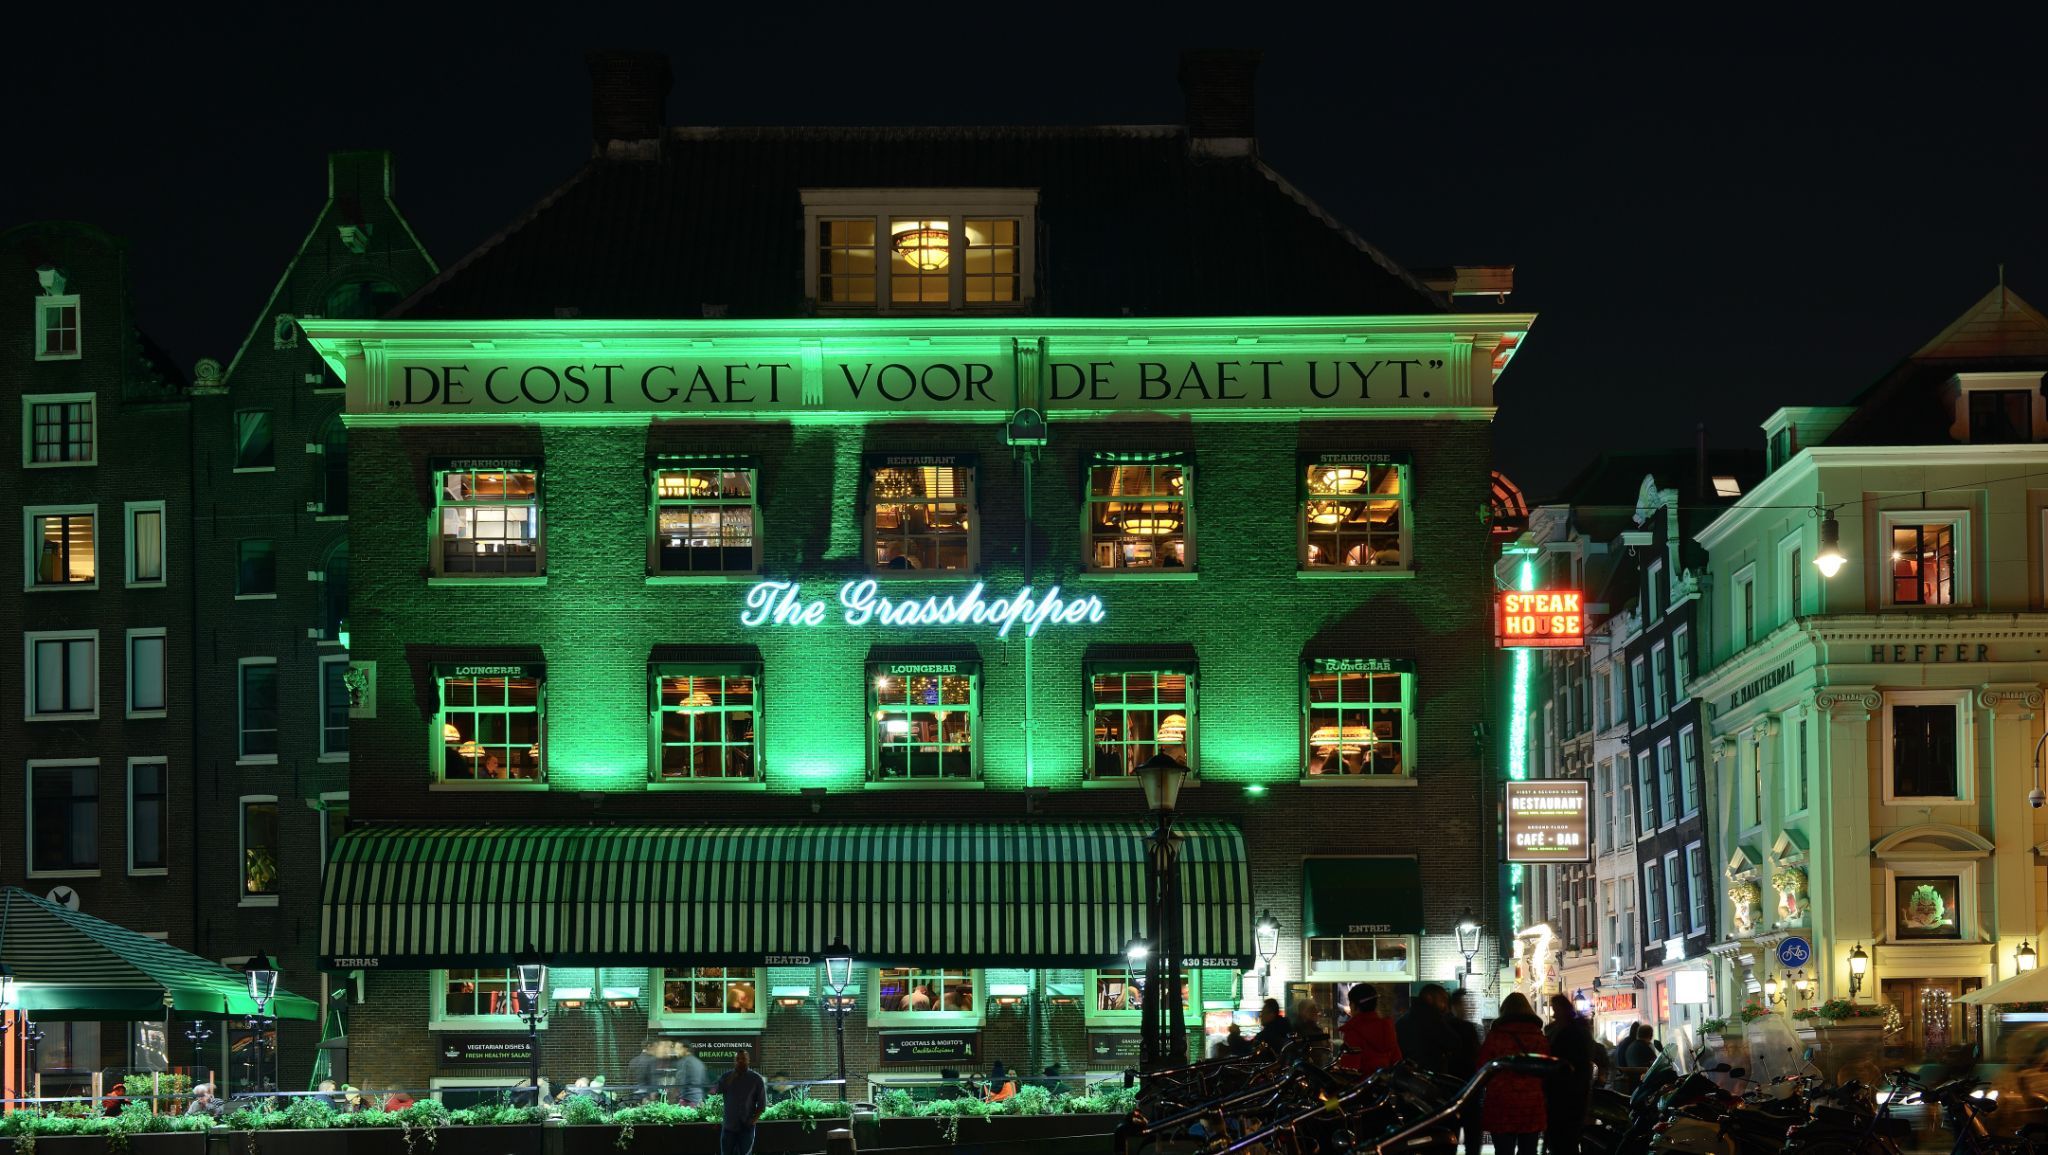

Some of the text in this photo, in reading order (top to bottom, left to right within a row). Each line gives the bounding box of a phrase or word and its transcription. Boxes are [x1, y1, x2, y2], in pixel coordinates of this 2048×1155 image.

[485, 363, 624, 404] COST
[640, 362, 792, 404] GAET
[839, 363, 998, 403] VOOR
[1048, 360, 1120, 401] DE
[1137, 359, 1285, 401] BAET
[886, 455, 956, 465] RESTAURANT
[1319, 453, 1391, 463] STEAKHOUSE
[450, 459, 522, 468] STEAKHOUSE
[1505, 593, 1579, 613] STEAK
[741, 579, 1106, 638] The Grasshopper
[1505, 615, 1580, 635] HOUSE
[1870, 643, 1989, 663] HEFFER
[455, 666, 521, 675] LOUNGEBAR
[891, 664, 957, 674] LOUNGEBAR
[1325, 661, 1391, 671] LOUNGEBAR
[1512, 797, 1583, 810] RESTAURANT
[1516, 831, 1545, 846] CAFÉ
[1556, 833, 1579, 846] BAR
[1348, 924, 1391, 933] ENTREE
[334, 958, 379, 967] TERRAS
[764, 956, 811, 965] HEATED
[1182, 958, 1239, 967] 430 SEATS
